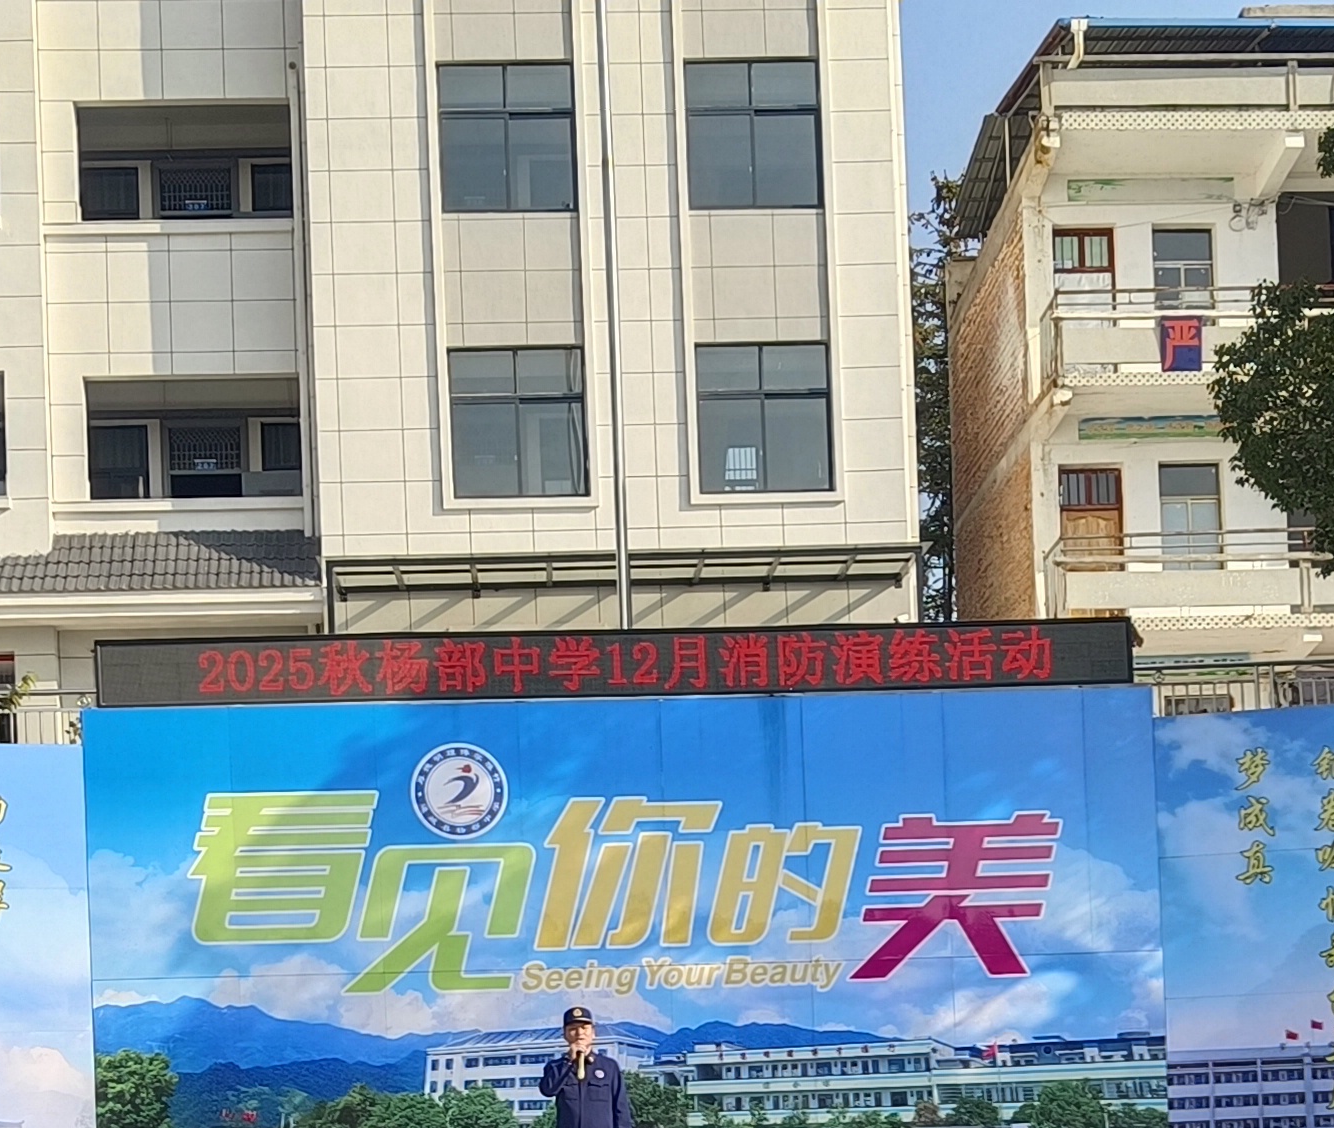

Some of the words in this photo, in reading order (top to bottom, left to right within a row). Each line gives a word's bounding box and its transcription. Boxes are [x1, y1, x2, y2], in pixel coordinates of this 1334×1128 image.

[1163, 318, 1199, 370] 严
[197, 627, 1053, 696] 2025秋杨部中学12月消防演练活动
[1235, 748, 1275, 886] 梦成真
[187, 790, 1063, 994] 看见你的美
[521, 960, 638, 995] Seeing
[642, 957, 721, 989] Your
[723, 956, 842, 991] Beauty
